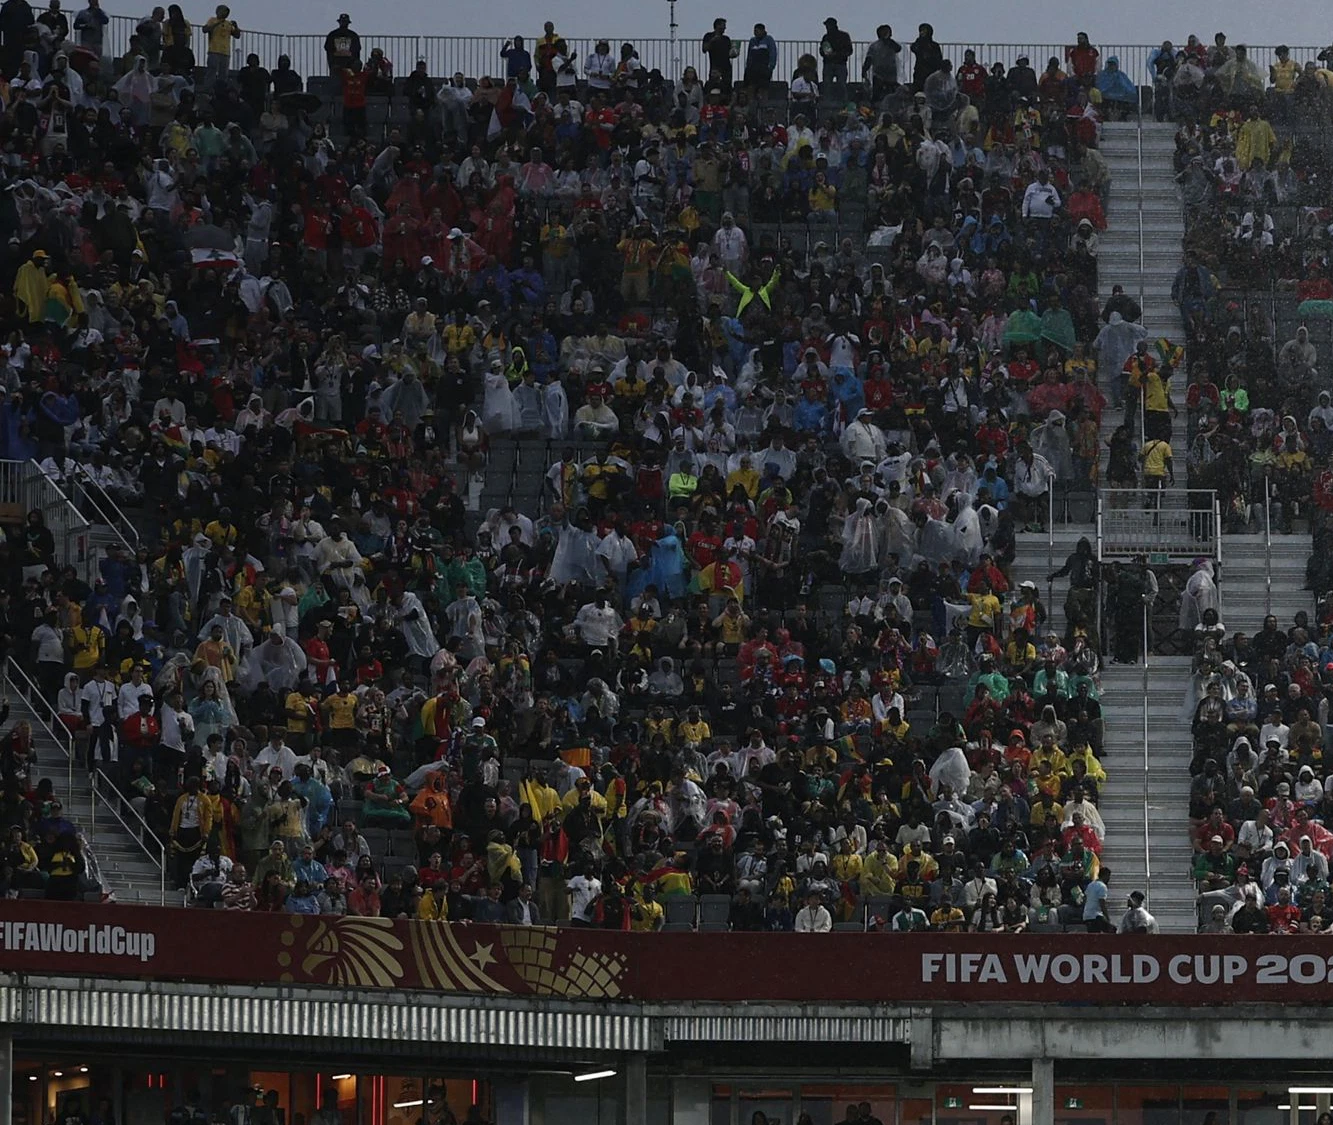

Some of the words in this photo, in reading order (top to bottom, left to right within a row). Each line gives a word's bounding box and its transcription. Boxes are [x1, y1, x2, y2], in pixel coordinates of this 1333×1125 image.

[921, 953, 1007, 984] FIFA
[1014, 953, 1160, 984] WORLD
[1168, 953, 1248, 984] CUP
